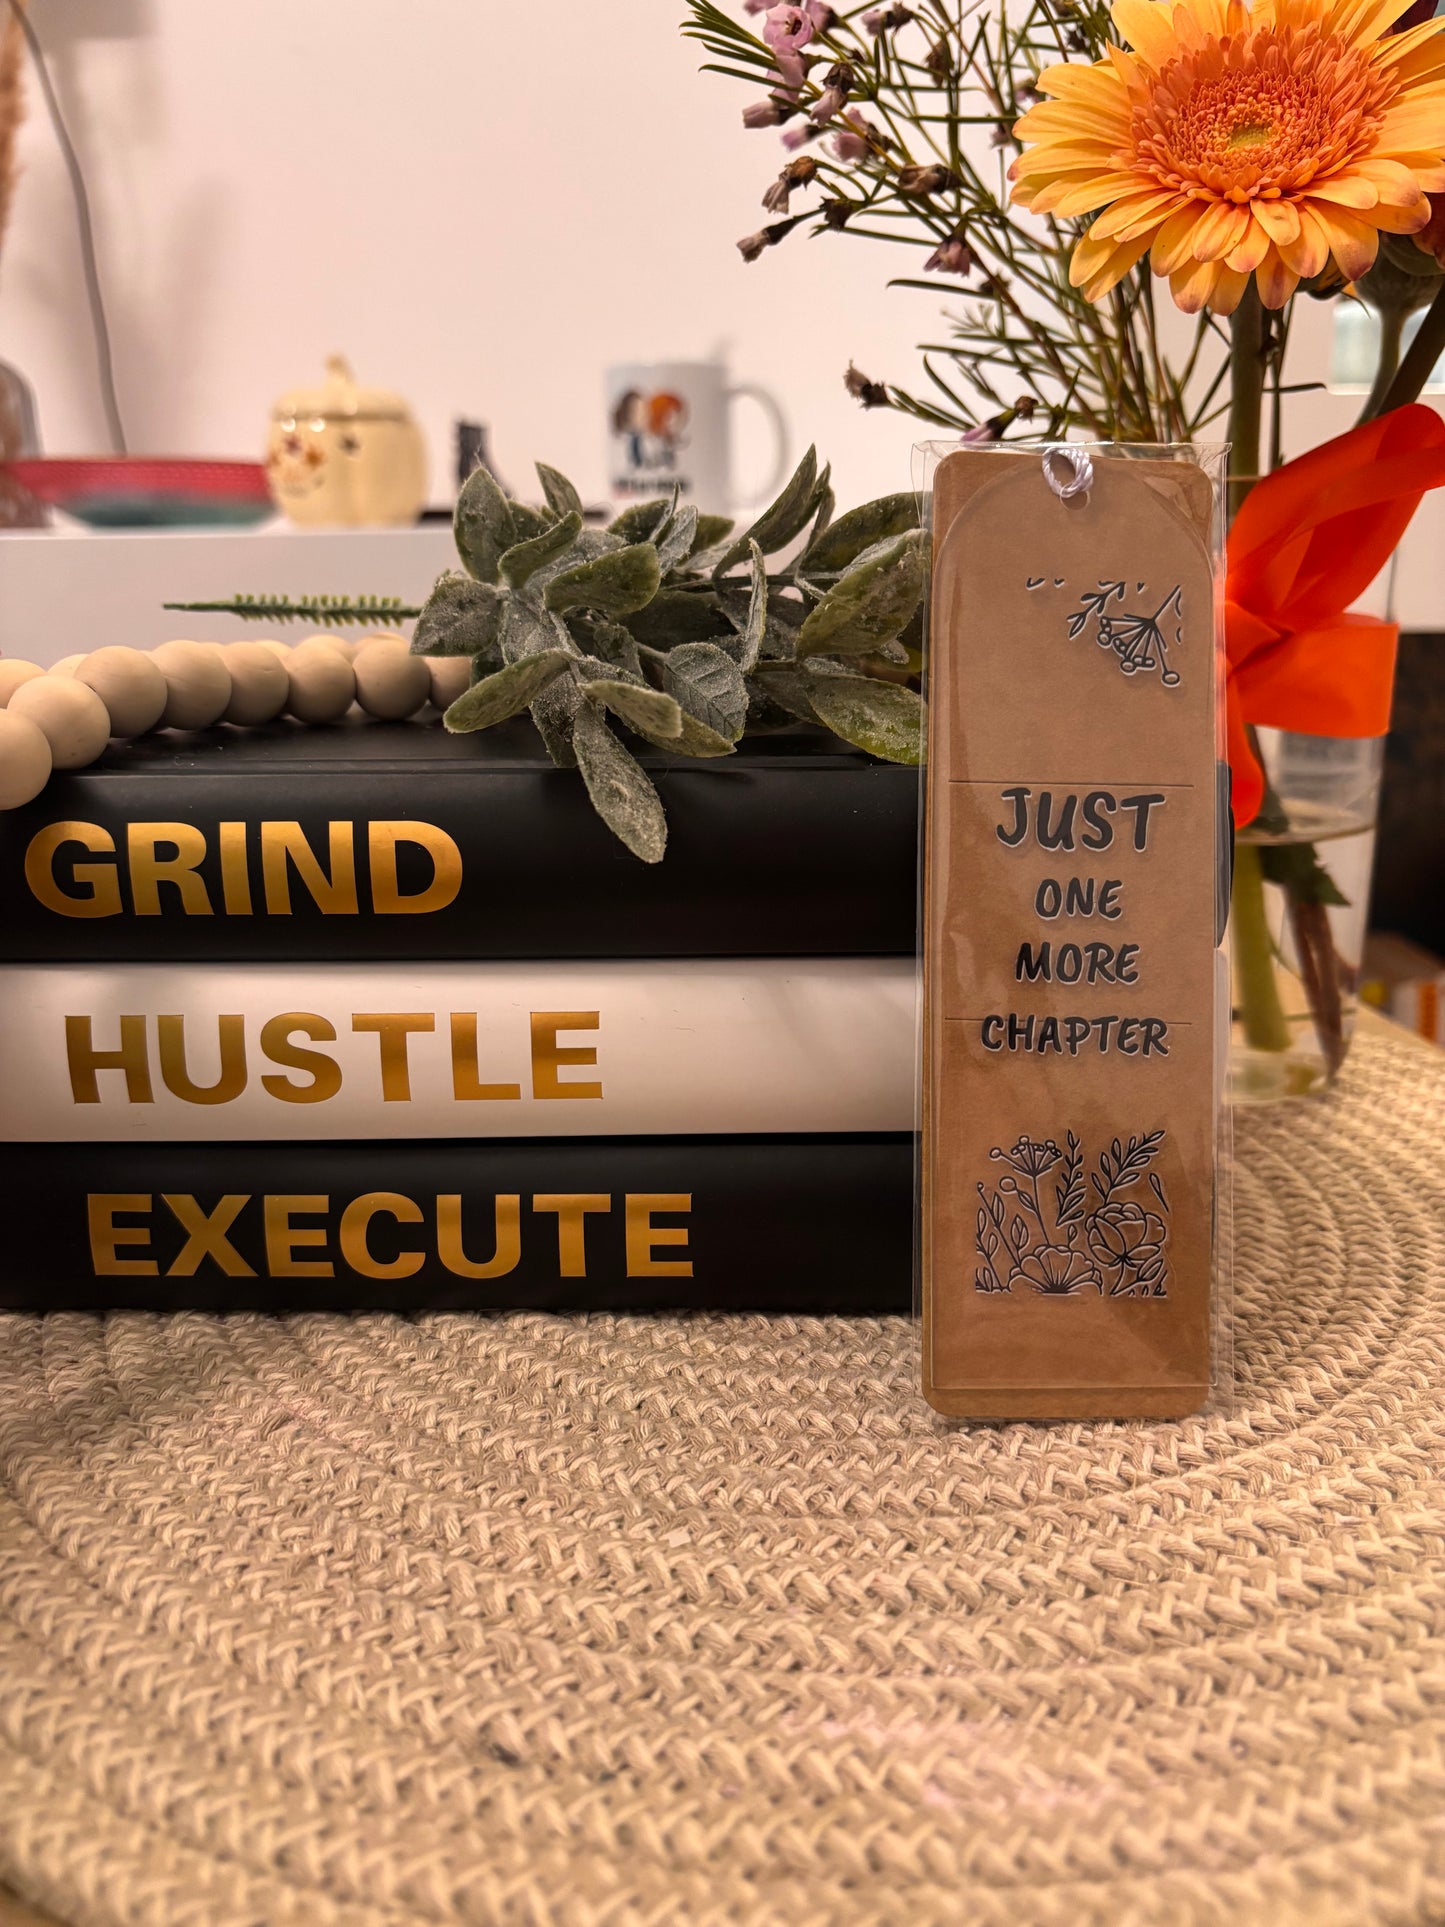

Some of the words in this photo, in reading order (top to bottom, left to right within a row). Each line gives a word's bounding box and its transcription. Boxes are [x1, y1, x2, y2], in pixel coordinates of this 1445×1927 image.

[996, 787, 1165, 852] JUST
[25, 820, 463, 918] GRIND
[1035, 877, 1123, 920] ONE
[1015, 942, 1140, 985] MORE
[64, 1011, 604, 1105] HUSTLE
[980, 1012, 1170, 1056] CHAPTER
[87, 1192, 694, 1279] EXECUTE
